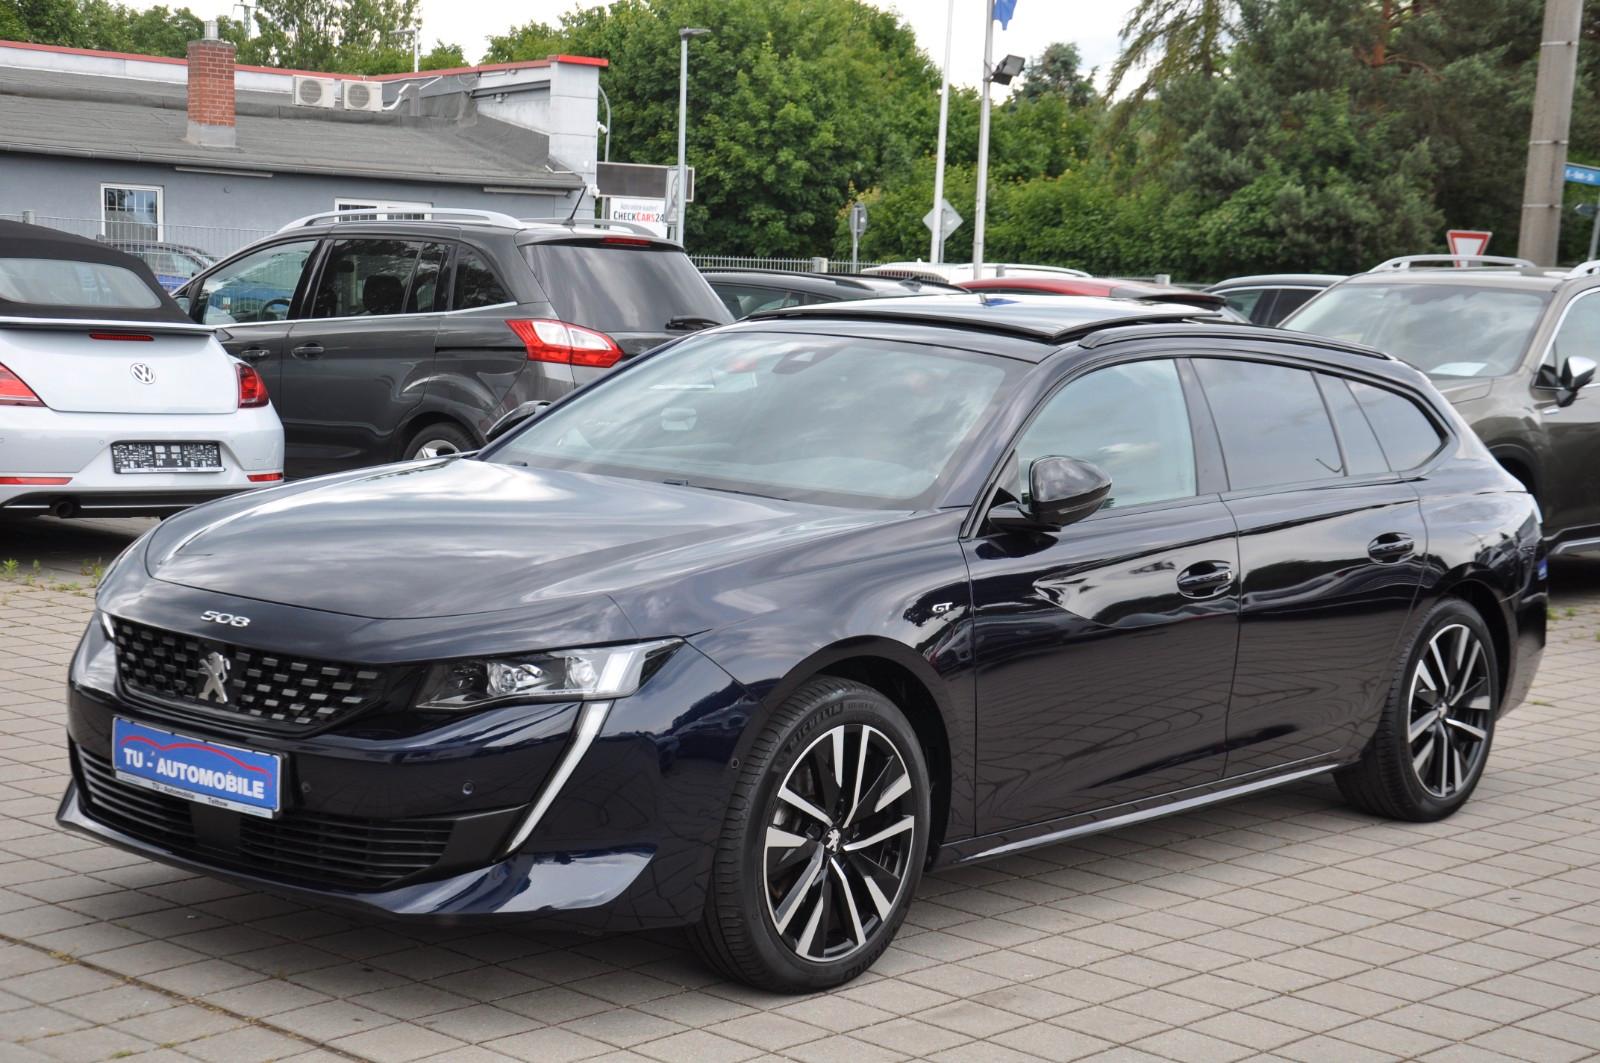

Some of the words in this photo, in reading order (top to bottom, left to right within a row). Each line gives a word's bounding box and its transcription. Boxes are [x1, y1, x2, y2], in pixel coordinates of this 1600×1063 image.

[932, 601, 953, 613] GT
[200, 610, 251, 628] 508
[123, 747, 144, 768] TU
[156, 757, 265, 800] AUTOMOBILE
